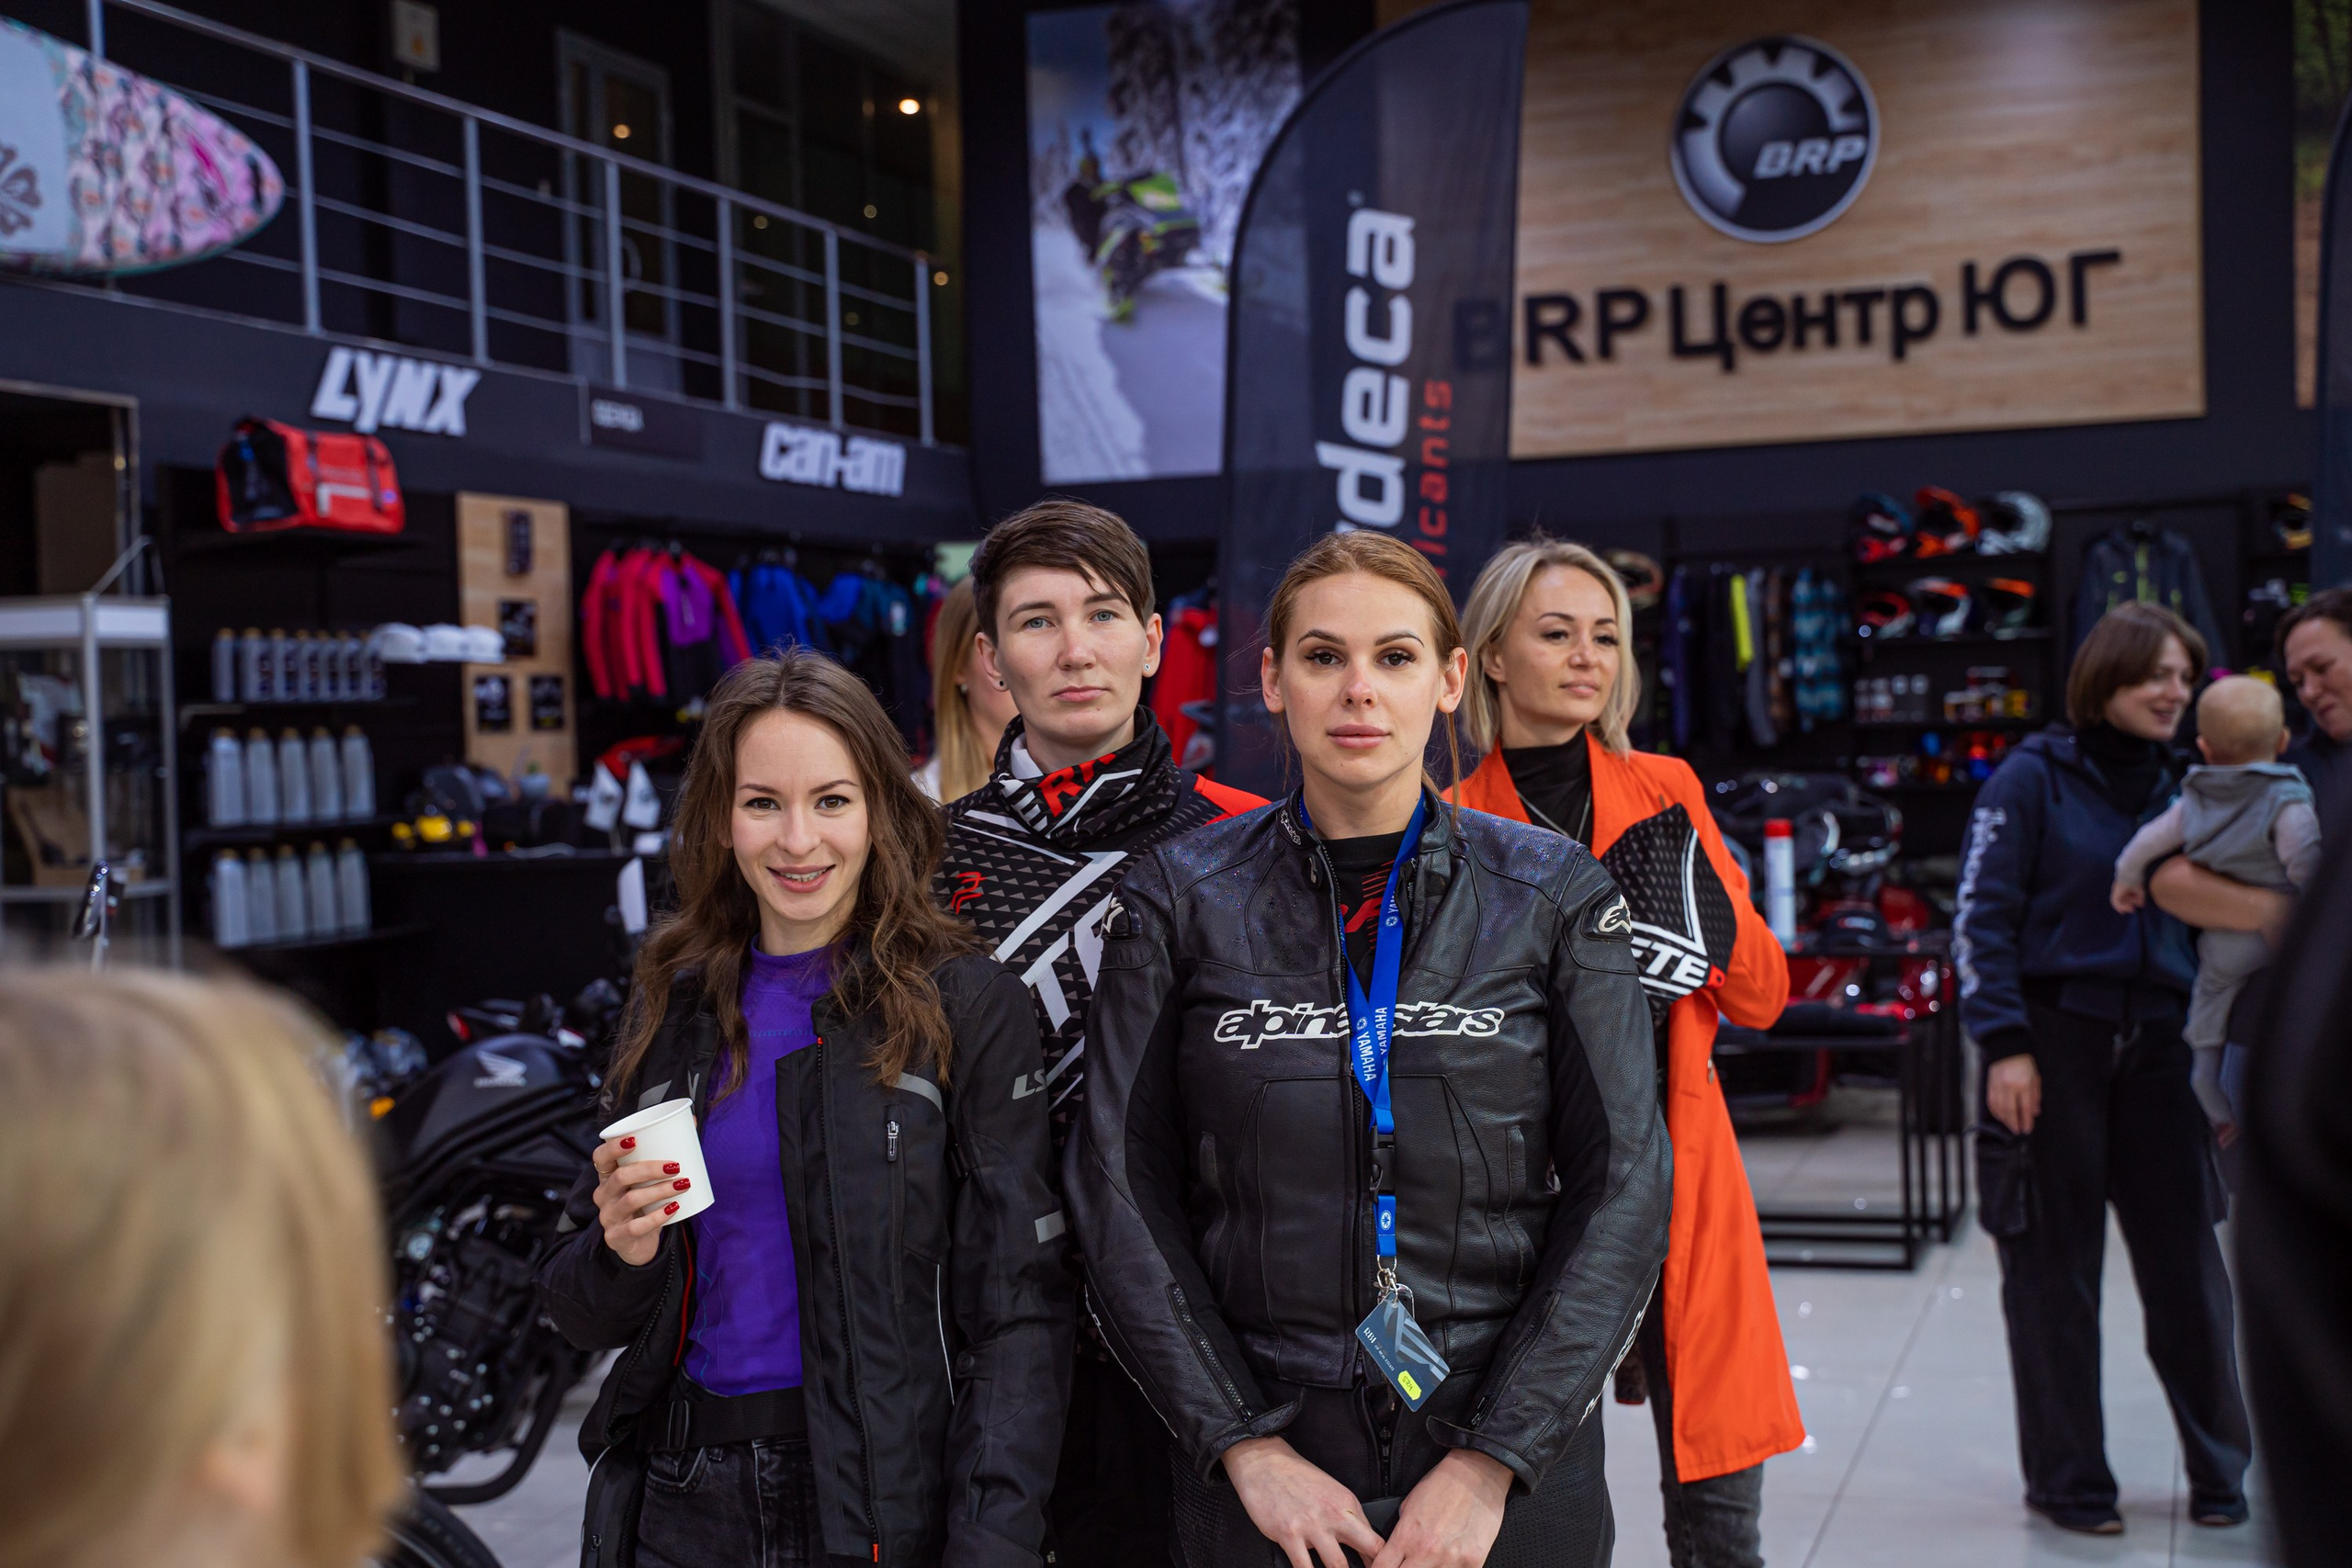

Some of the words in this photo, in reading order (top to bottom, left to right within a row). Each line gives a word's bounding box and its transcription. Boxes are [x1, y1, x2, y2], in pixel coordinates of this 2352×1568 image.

[1752, 133, 1868, 180] BRP
[1959, 247, 2120, 338] ЮГ
[311, 344, 483, 438] LYNX
[1315, 208, 1416, 534] deca
[759, 421, 908, 497] can-am
[1357, 1031, 1377, 1081] YAMAHA
[1374, 1007, 1387, 1055] YAMAHA
